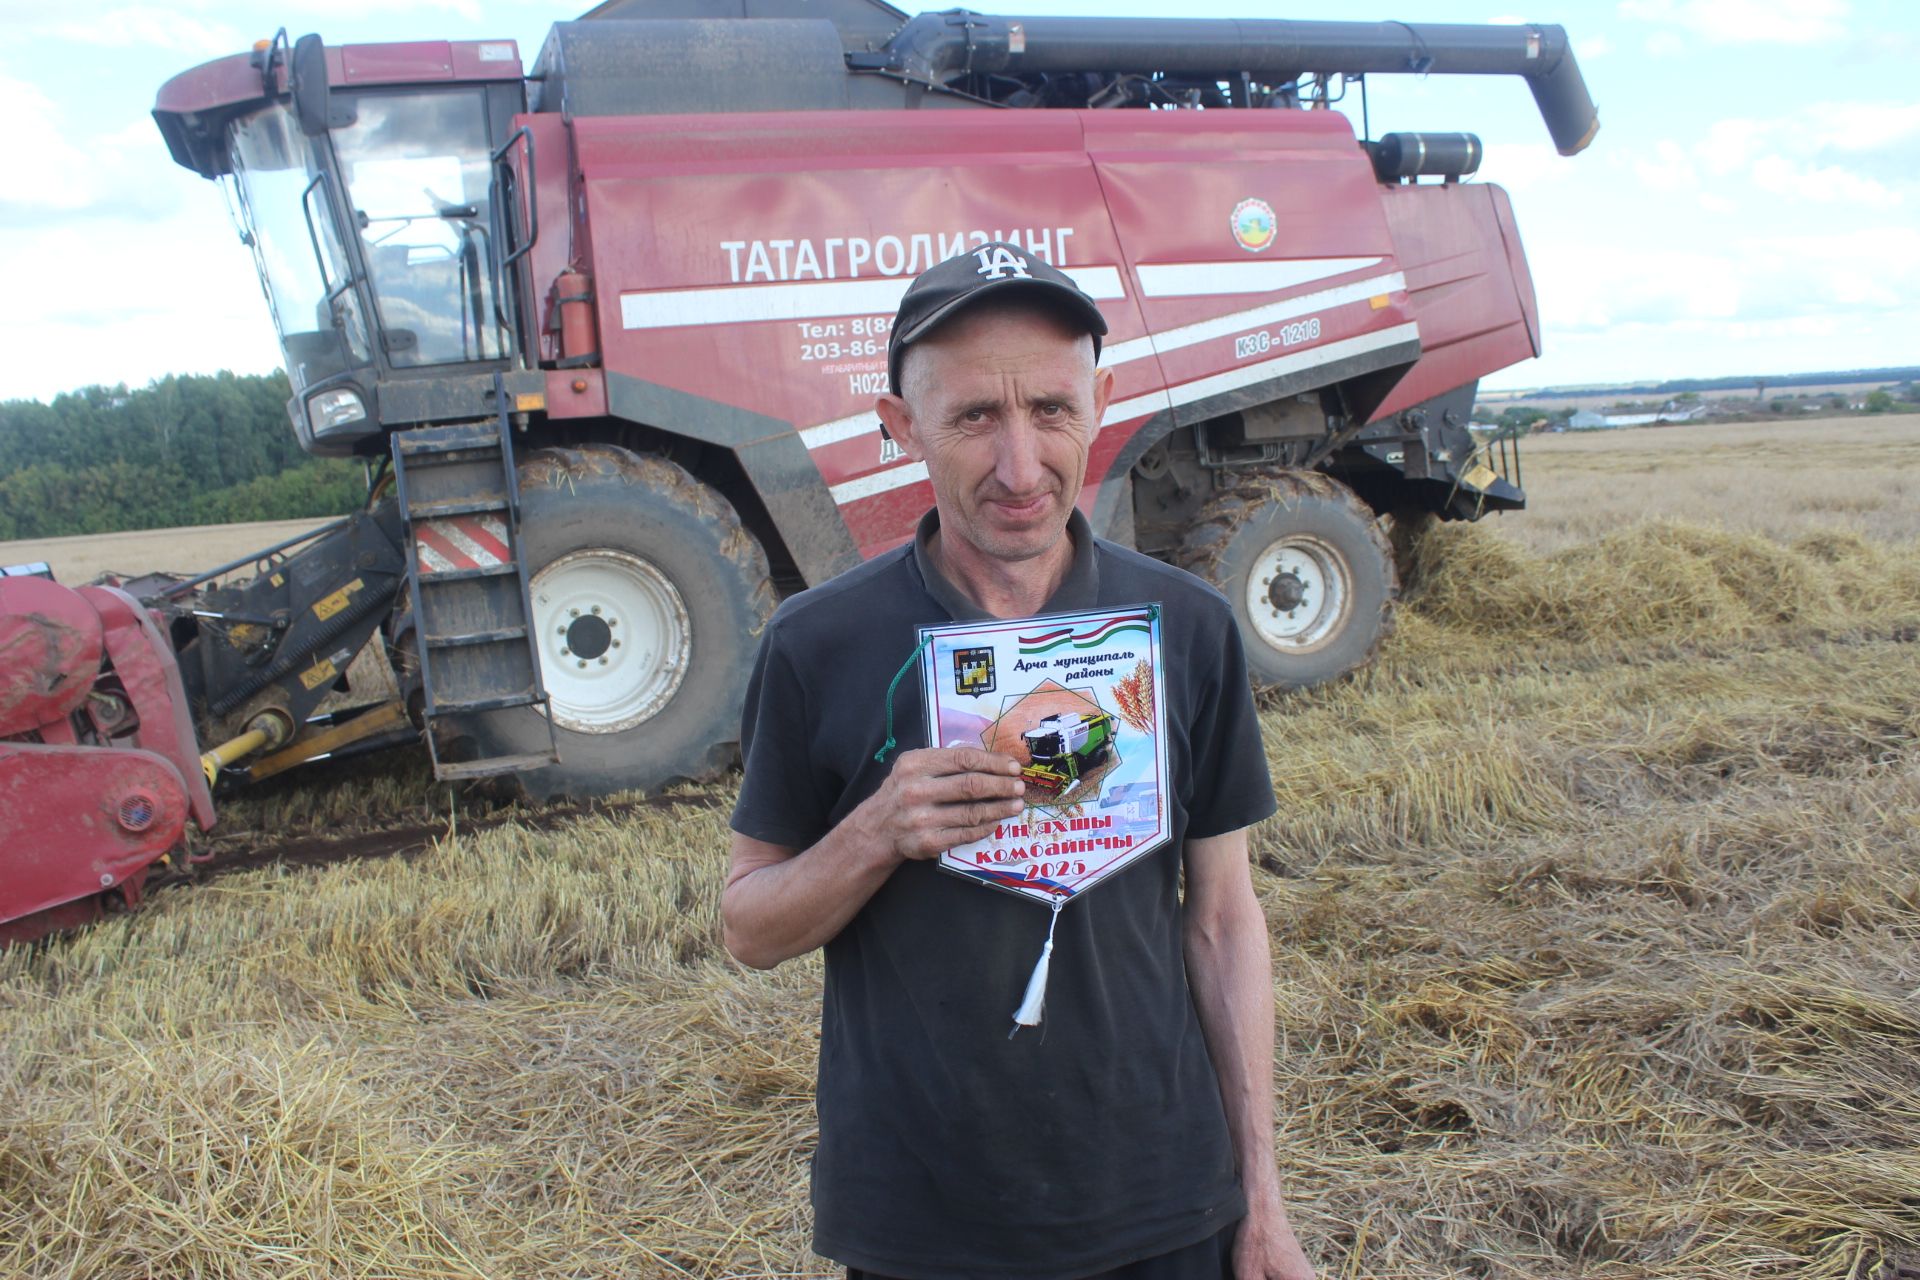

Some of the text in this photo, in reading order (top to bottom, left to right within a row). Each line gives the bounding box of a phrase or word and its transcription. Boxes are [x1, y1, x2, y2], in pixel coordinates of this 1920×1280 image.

[972, 246, 1032, 280] LA
[798, 322, 845, 338] Тел:
[800, 339, 889, 360] 203-86-
[1013, 651, 1135, 673] Арча муниципаль
[1065, 667, 1114, 683] районы
[975, 834, 1133, 865] комбайнчы
[1024, 860, 1086, 882] 2025
